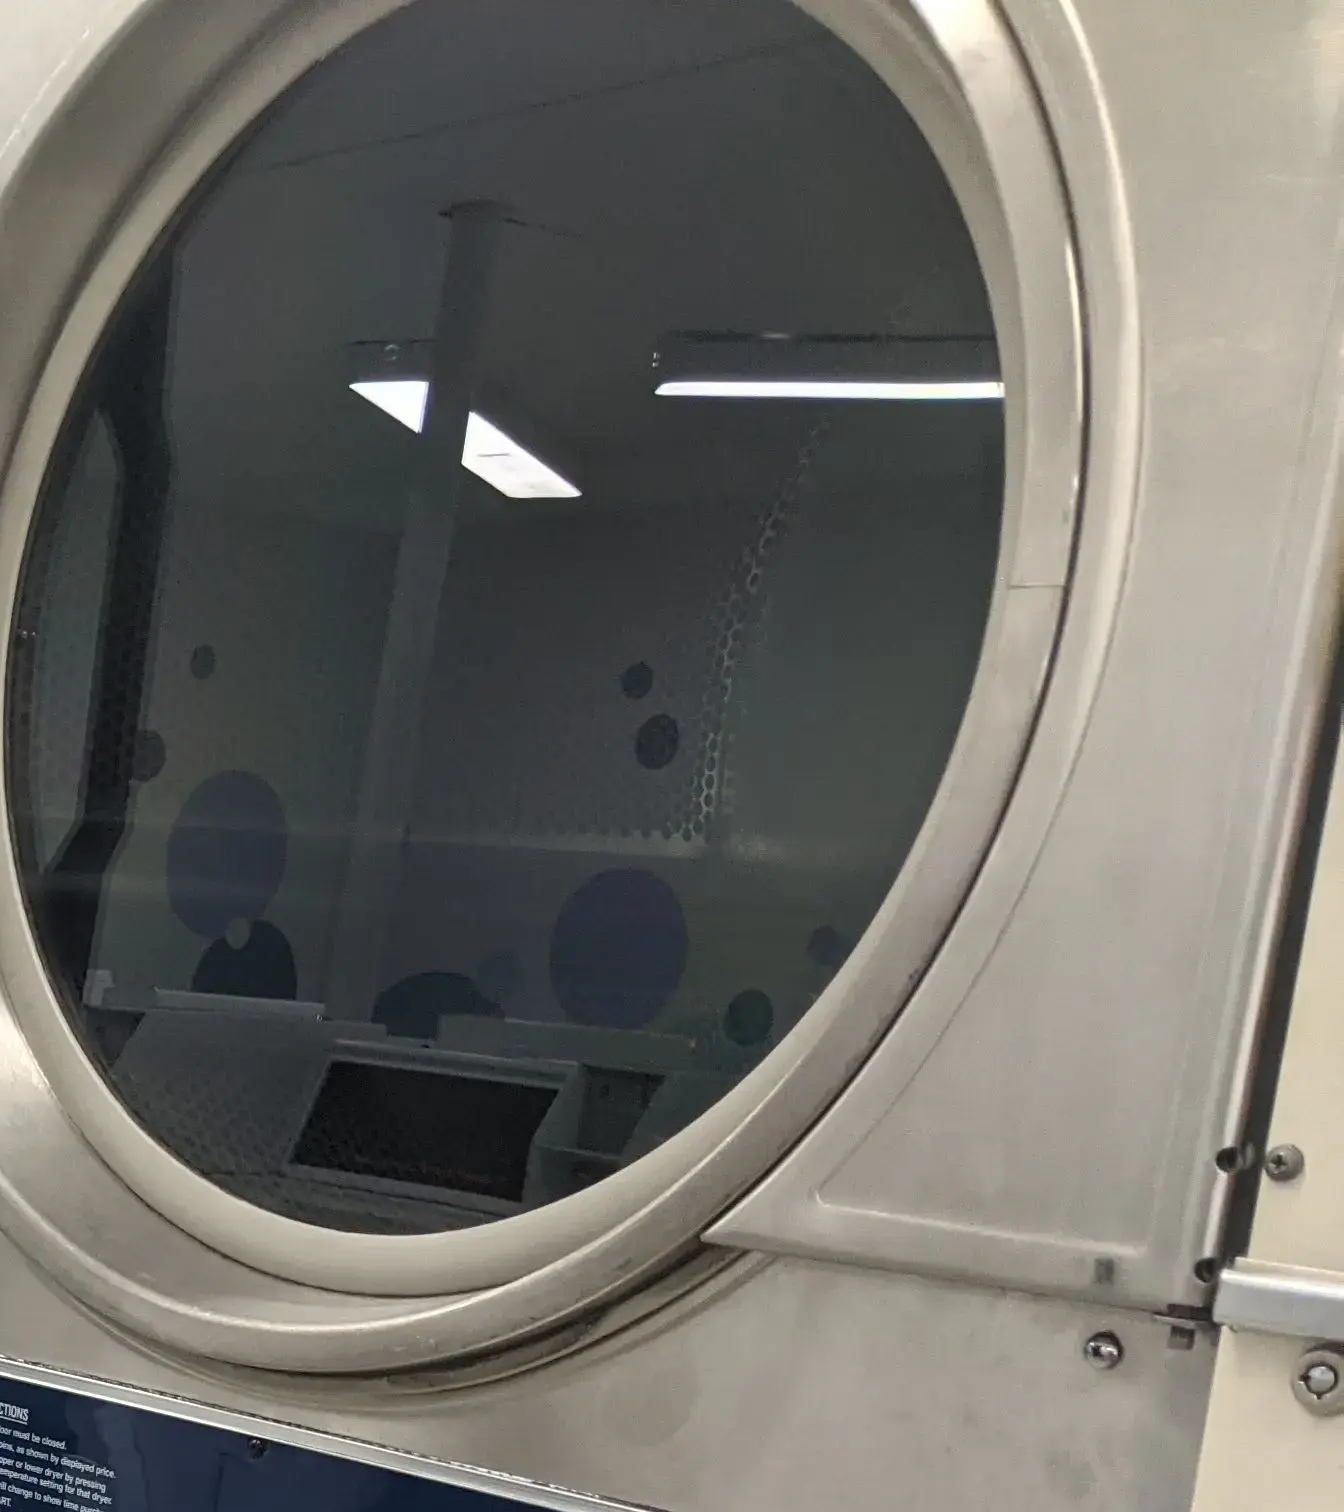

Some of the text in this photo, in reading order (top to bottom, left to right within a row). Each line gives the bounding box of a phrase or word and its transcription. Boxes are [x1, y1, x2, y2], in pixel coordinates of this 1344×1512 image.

[42, 1436, 67, 1450] closed.
[50, 1453, 60, 1466] by
[95, 1466, 116, 1479] price.
[44, 1468, 64, 1480] dryer
[65, 1472, 74, 1485] by
[75, 1477, 106, 1494] pressing
[76, 1488, 90, 1499] that
[7, 1484, 33, 1499] change
[34, 1491, 42, 1501] to
[42, 1495, 63, 1506] show
[63, 1500, 79, 1512] time
